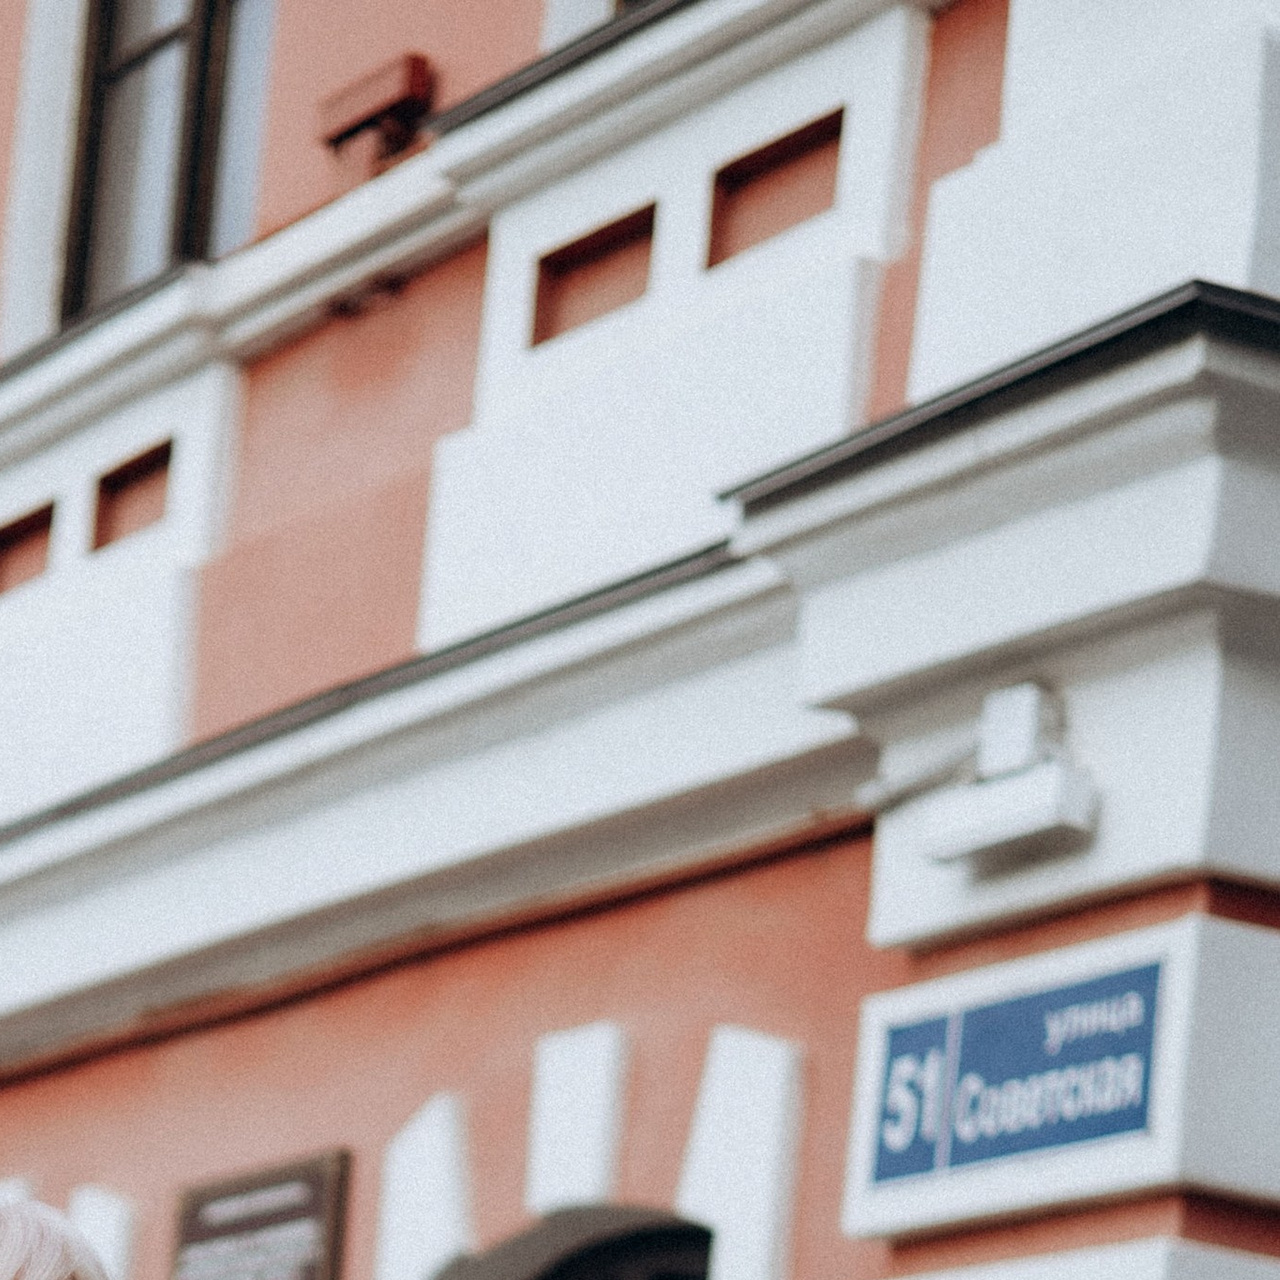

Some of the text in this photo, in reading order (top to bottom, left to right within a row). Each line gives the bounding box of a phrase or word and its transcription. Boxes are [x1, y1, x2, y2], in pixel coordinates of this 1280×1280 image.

[1044, 992, 1143, 1055] улица
[882, 1049, 942, 1152] 51
[955, 1053, 1144, 1142] Советская
